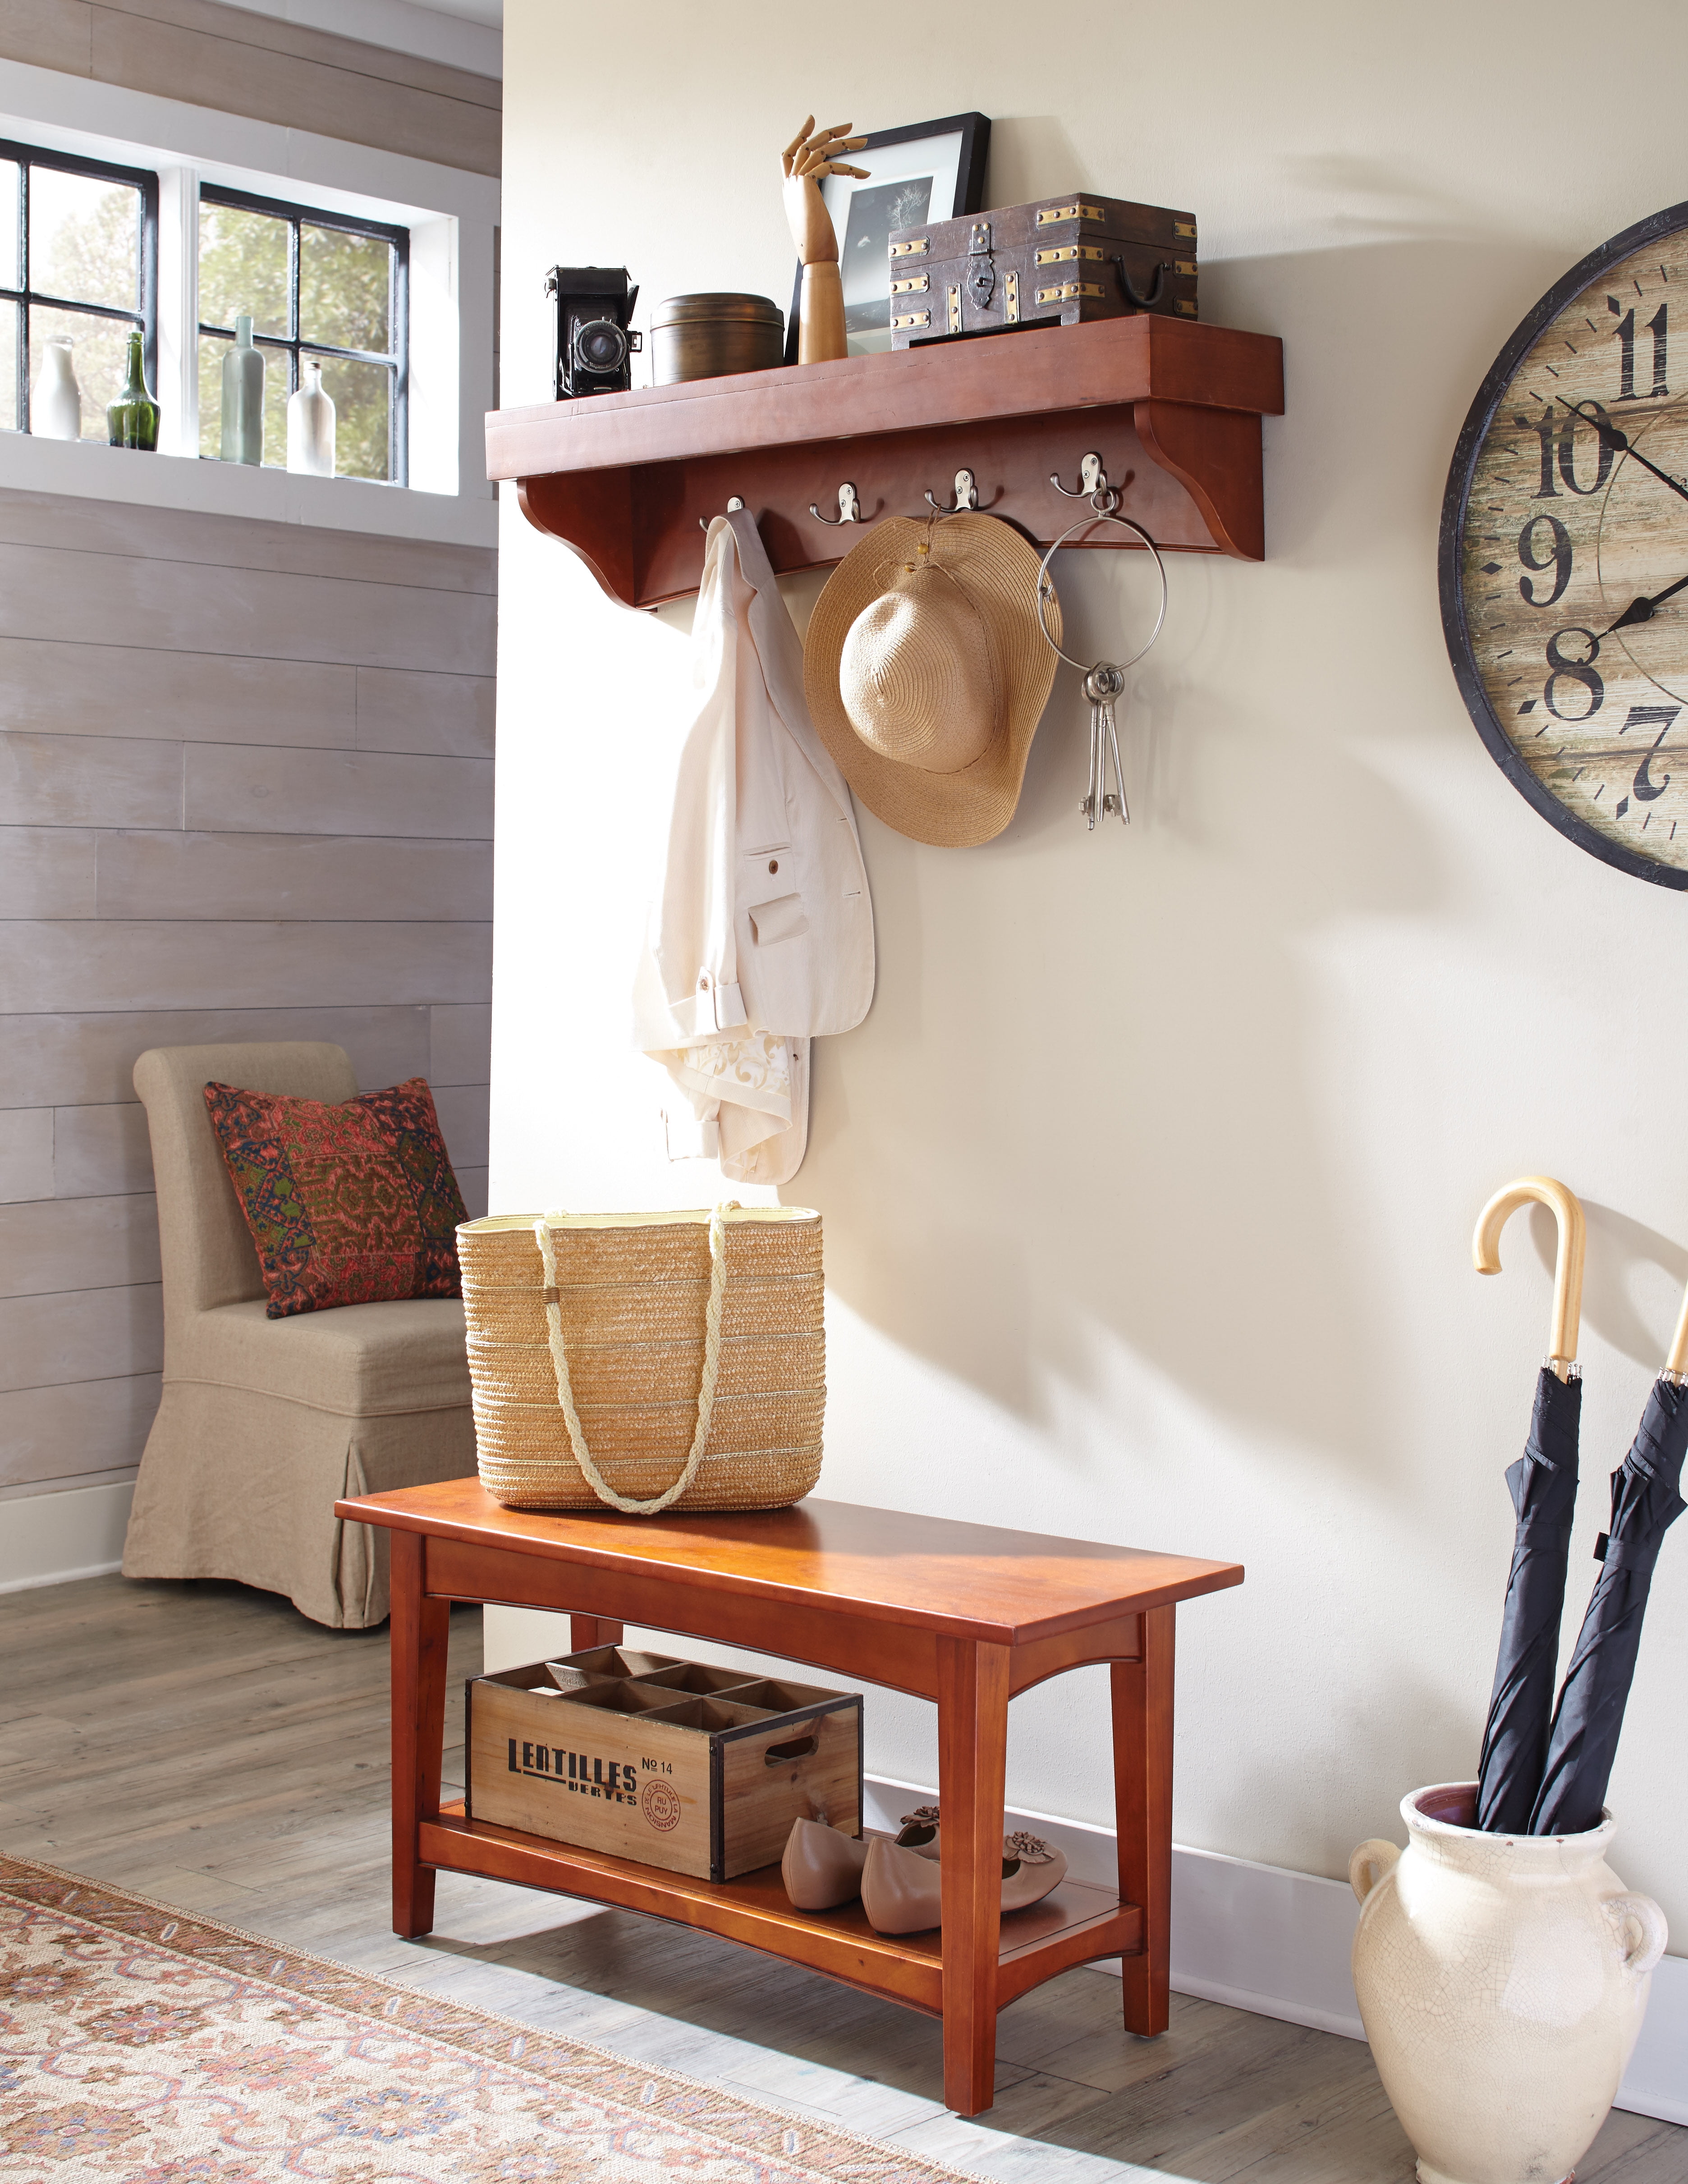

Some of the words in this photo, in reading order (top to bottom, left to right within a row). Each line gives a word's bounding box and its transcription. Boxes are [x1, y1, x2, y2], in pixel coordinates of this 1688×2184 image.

[1610, 302, 1670, 403] 11
[1530, 398, 1615, 499] 10
[1518, 514, 1573, 608] 9
[1544, 627, 1605, 721] 8
[1619, 706, 1682, 801] 7
[509, 1738, 637, 1792] LENTILLES
[661, 1761, 673, 1774] 14
[645, 1807, 677, 1828] MANSION
[655, 1805, 668, 1815] PUY
[657, 1796, 666, 1805] RU
[674, 1804, 678, 1813] LA
